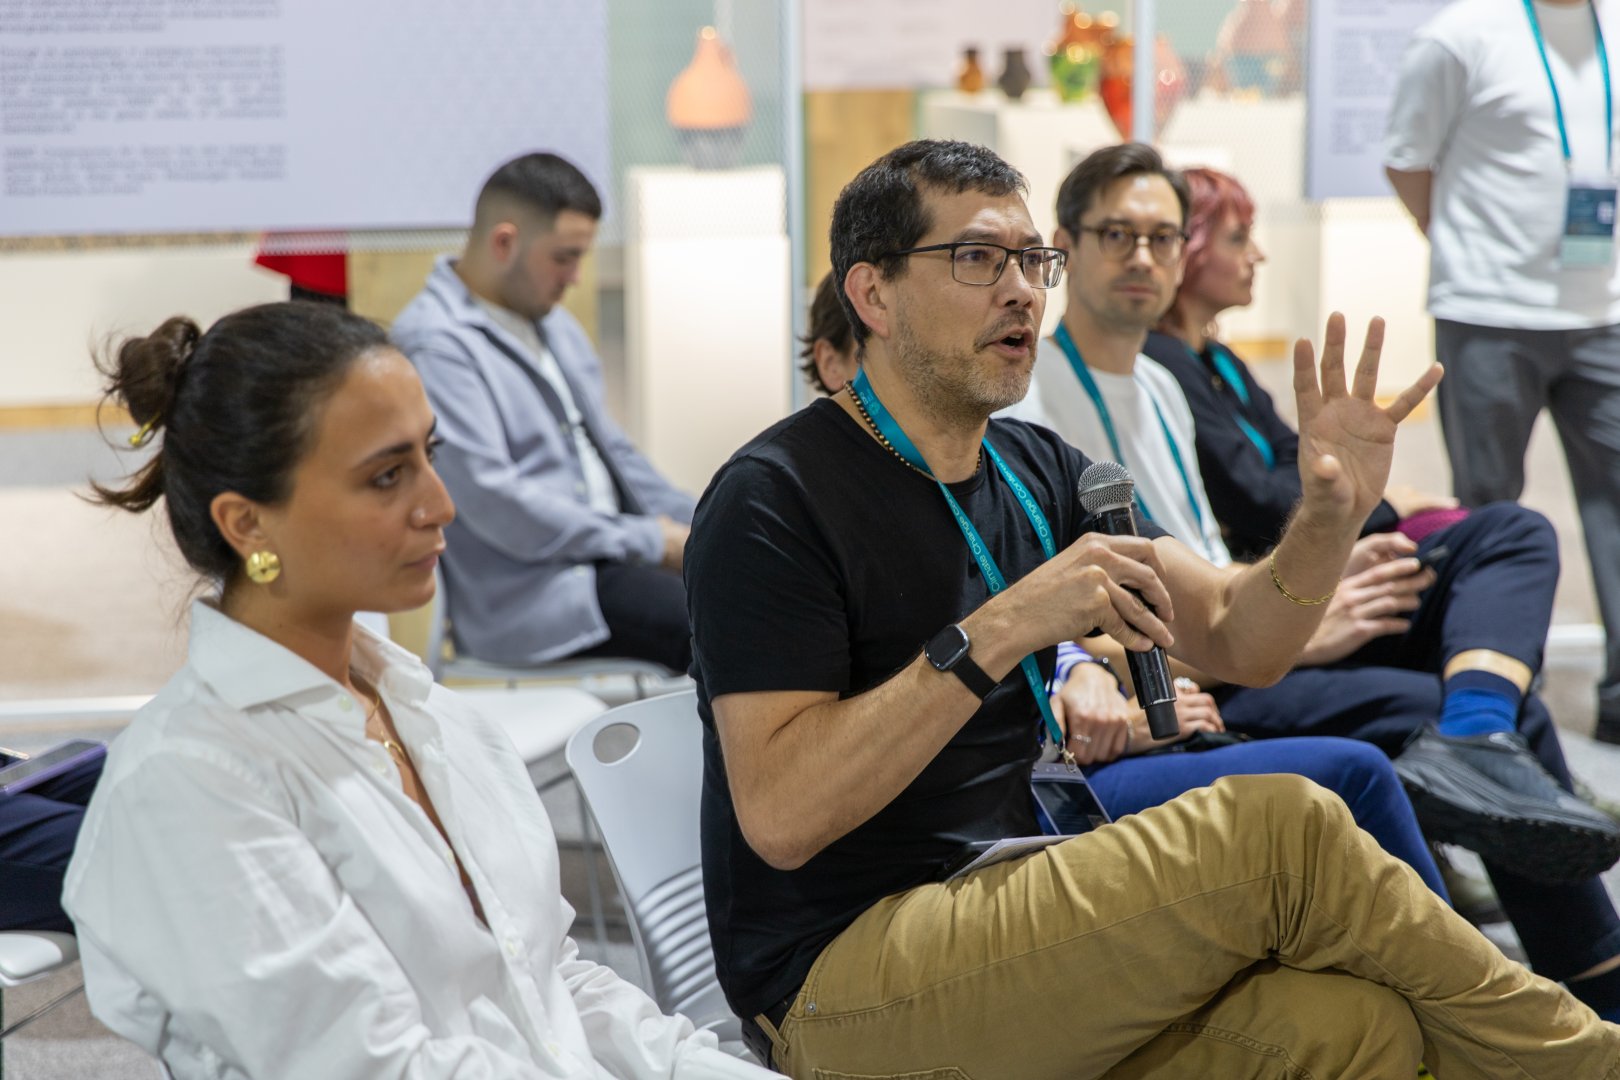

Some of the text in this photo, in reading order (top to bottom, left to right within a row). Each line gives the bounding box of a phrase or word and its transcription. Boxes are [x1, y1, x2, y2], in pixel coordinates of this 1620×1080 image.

[1025, 499, 1048, 538] Change
[959, 516, 1000, 592] Climate Change
